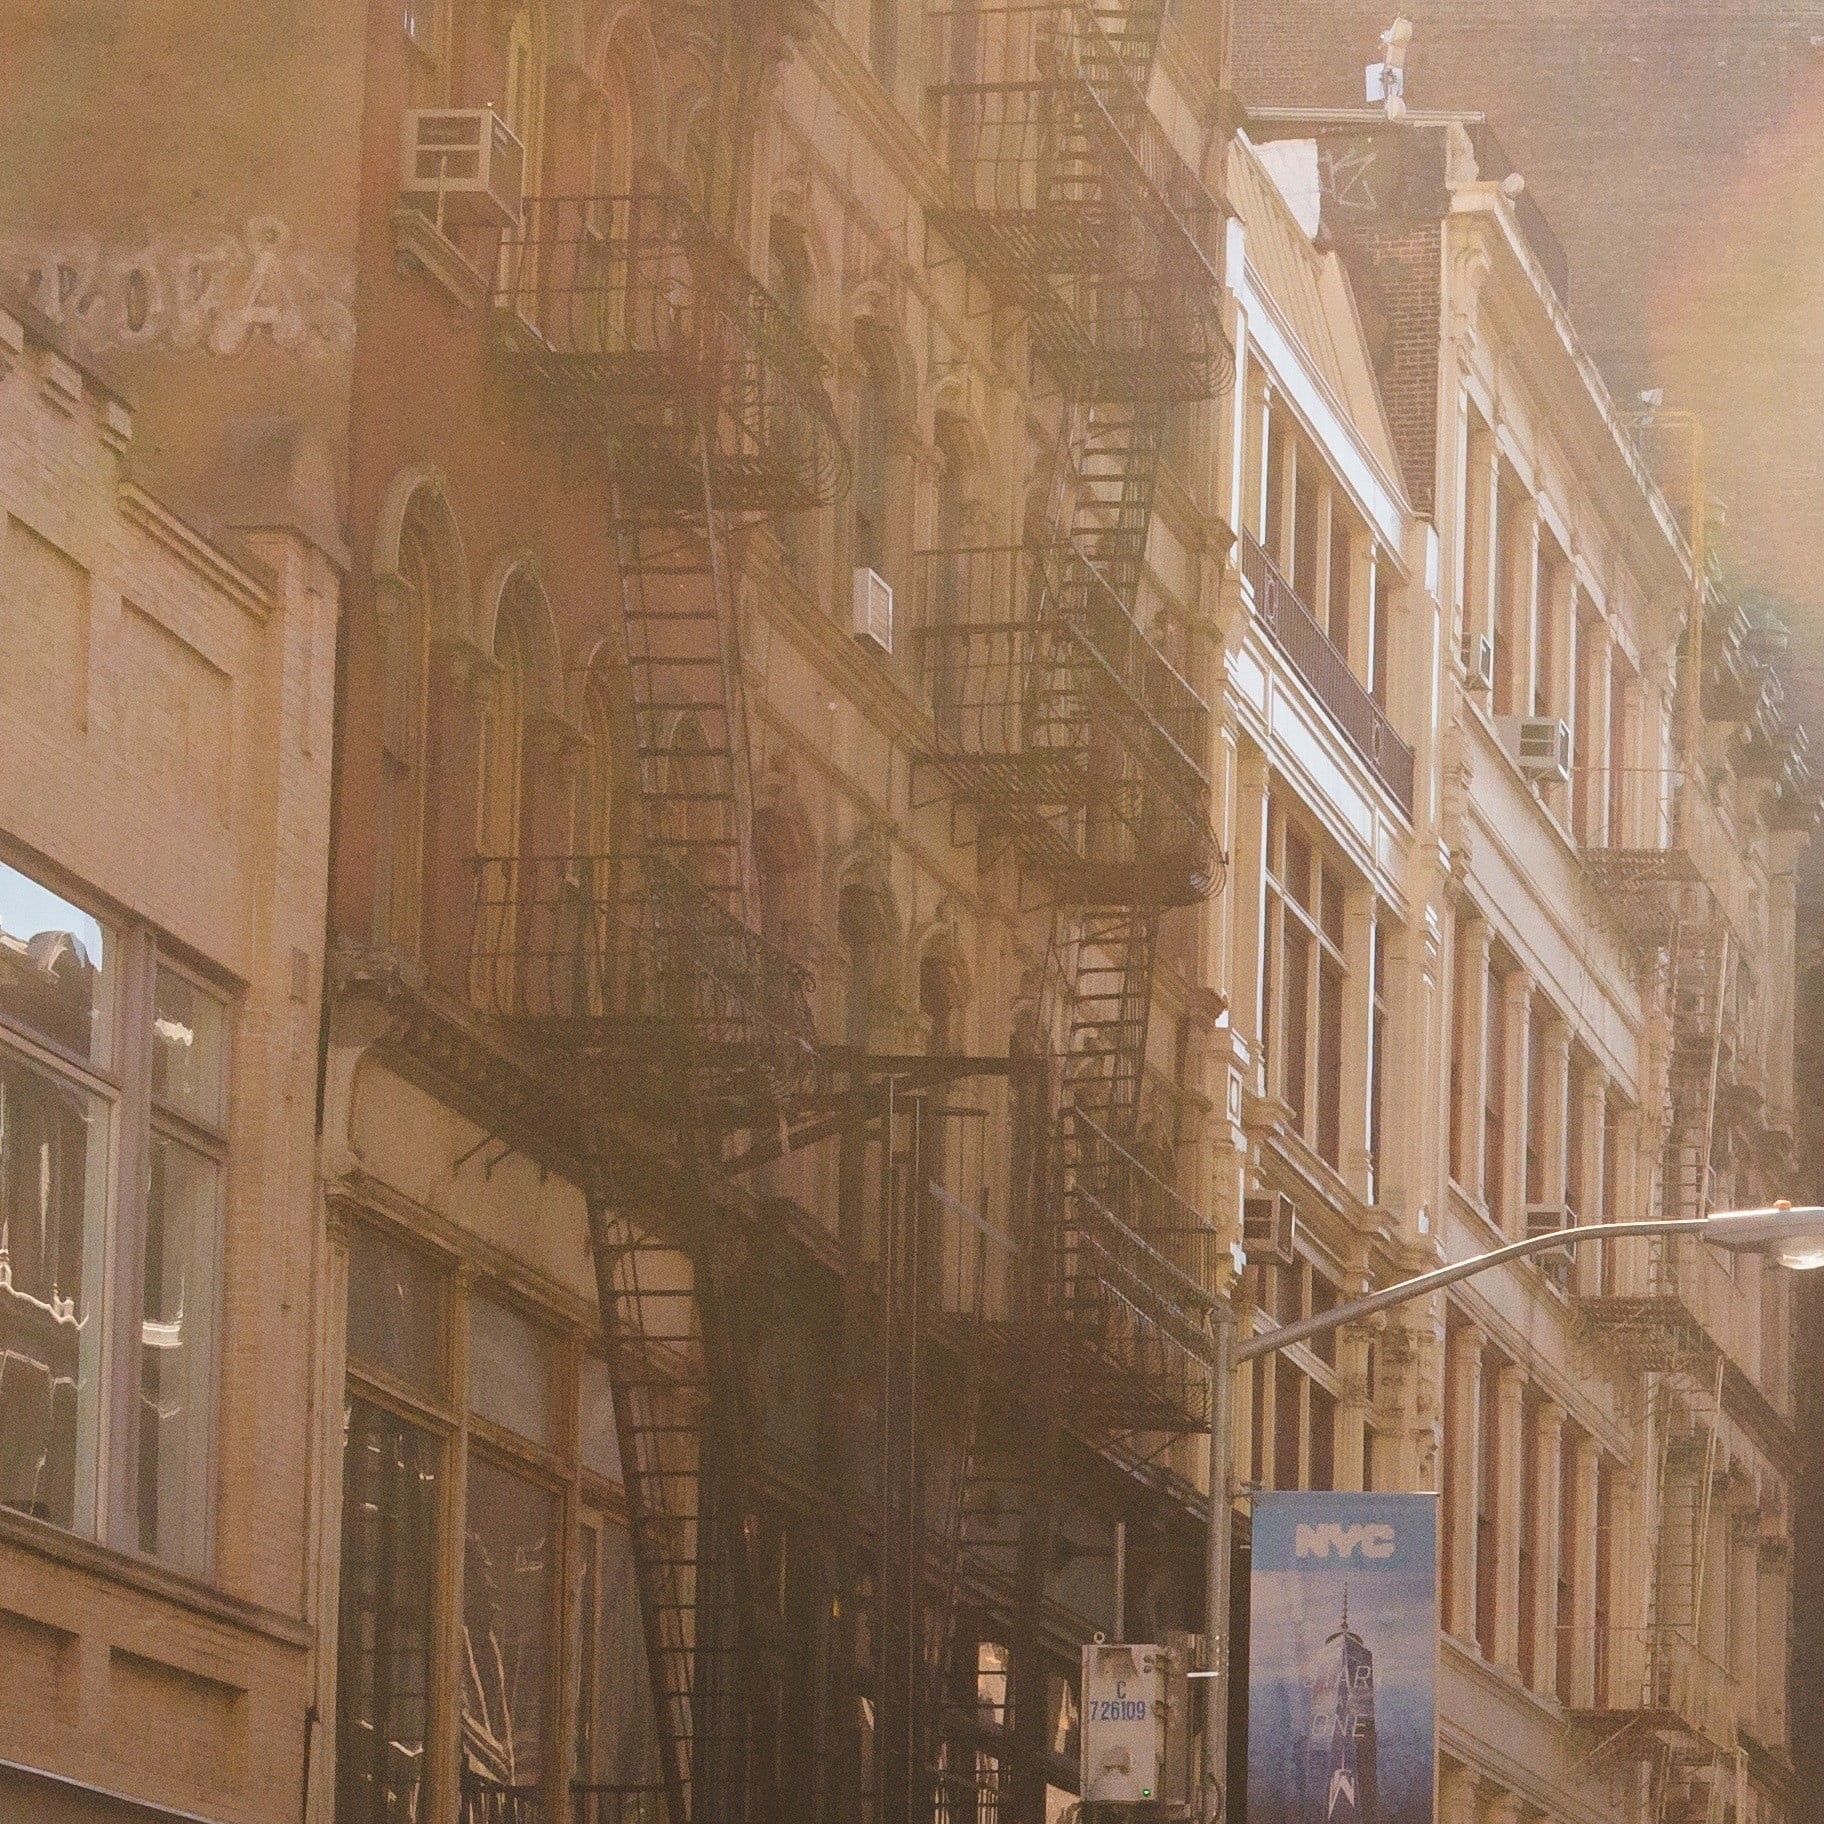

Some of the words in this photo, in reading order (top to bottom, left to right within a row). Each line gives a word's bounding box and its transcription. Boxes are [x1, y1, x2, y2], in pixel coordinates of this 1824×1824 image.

[1295, 1523, 1396, 1559] NYC
[1117, 1681, 1127, 1700] C
[1089, 1700, 1146, 1721] 726109
[1311, 1714, 1369, 1740] ONE
